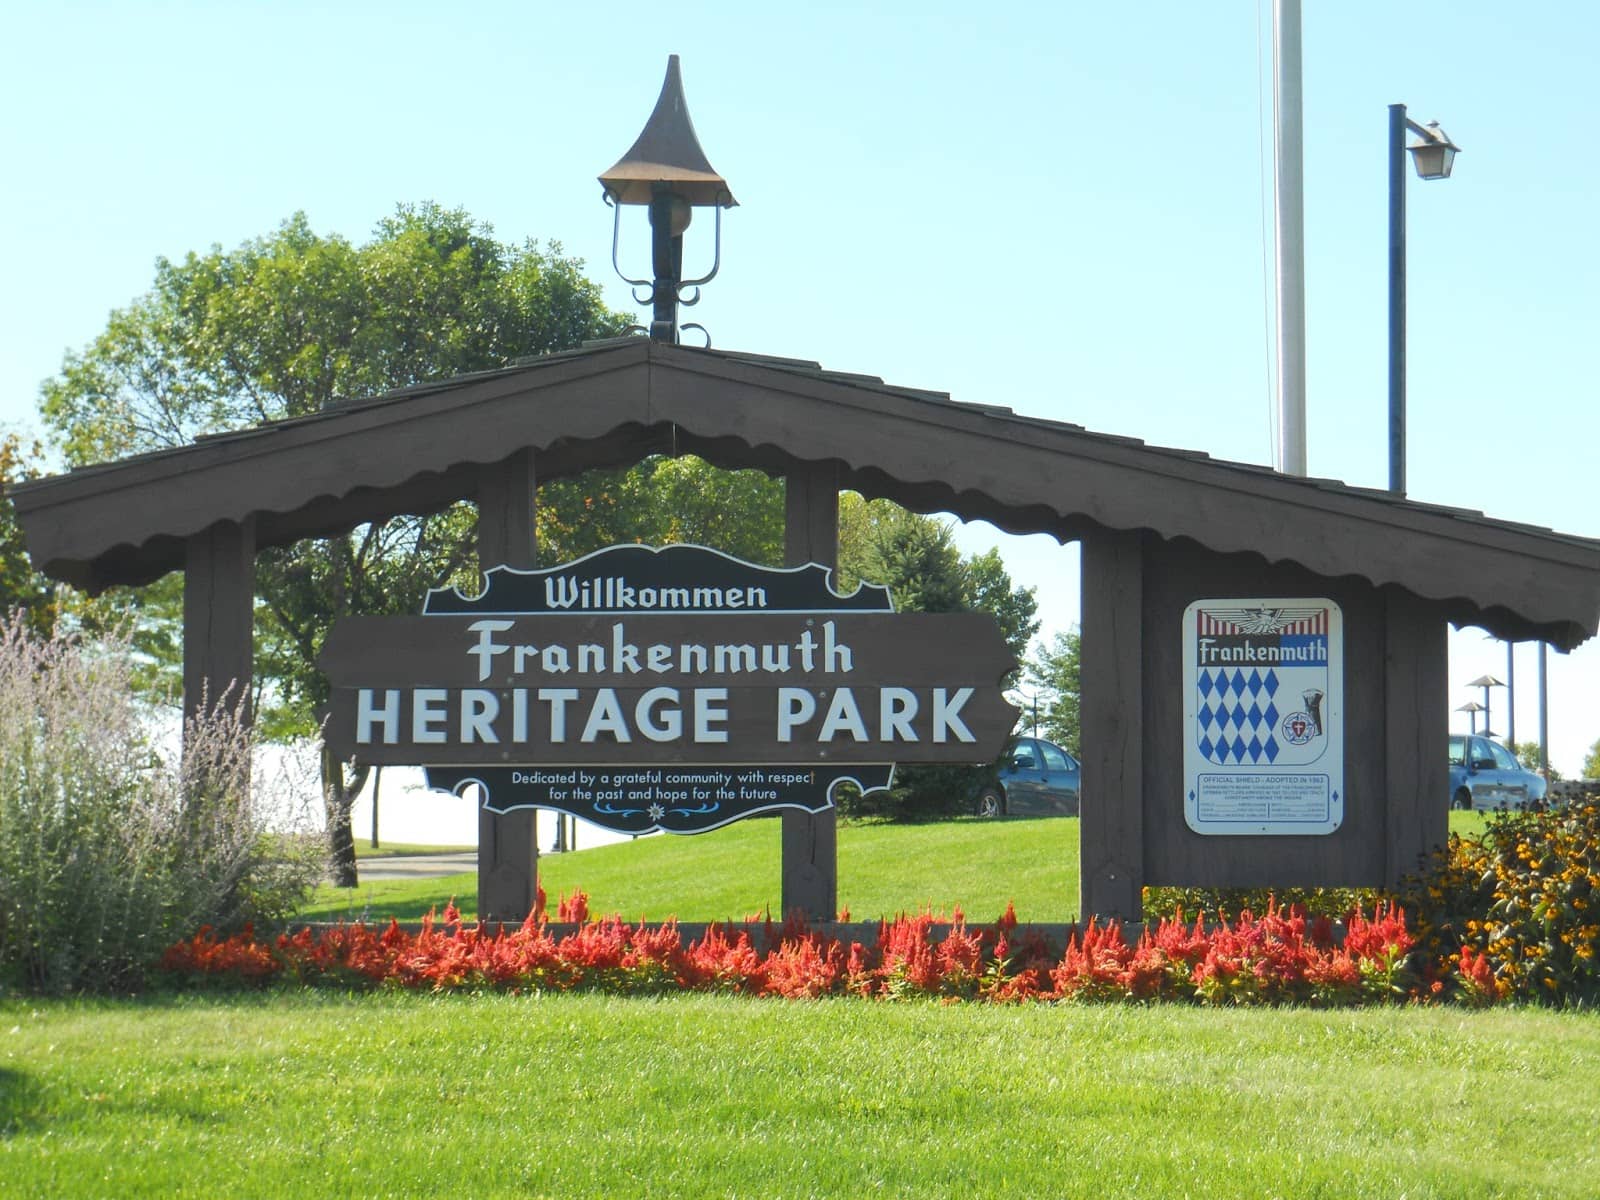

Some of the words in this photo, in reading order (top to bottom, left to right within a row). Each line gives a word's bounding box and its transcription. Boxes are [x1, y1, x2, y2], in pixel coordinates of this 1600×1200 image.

[545, 577, 767, 608] Willkommen
[467, 621, 853, 681] Frankenmuth
[1199, 638, 1327, 665] Frankenmuth
[355, 688, 729, 744] HERITAGE
[777, 687, 976, 743] PARK
[512, 771, 576, 784] Dedicated
[580, 771, 595, 787] by
[600, 775, 609, 784] a
[613, 771, 662, 787] grateful
[665, 771, 732, 787] community
[737, 770, 764, 783] with
[768, 770, 815, 786] respect
[1236, 776, 1261, 784] SHIELD
[1266, 776, 1299, 784] ADOPTED
[1300, 776, 1308, 784] IN
[549, 787, 568, 800] for
[572, 787, 592, 800] the
[596, 788, 624, 803] past
[628, 787, 651, 800] and
[656, 787, 688, 803] hope
[692, 787, 711, 800] for
[716, 787, 735, 800] the
[740, 787, 777, 800] future
